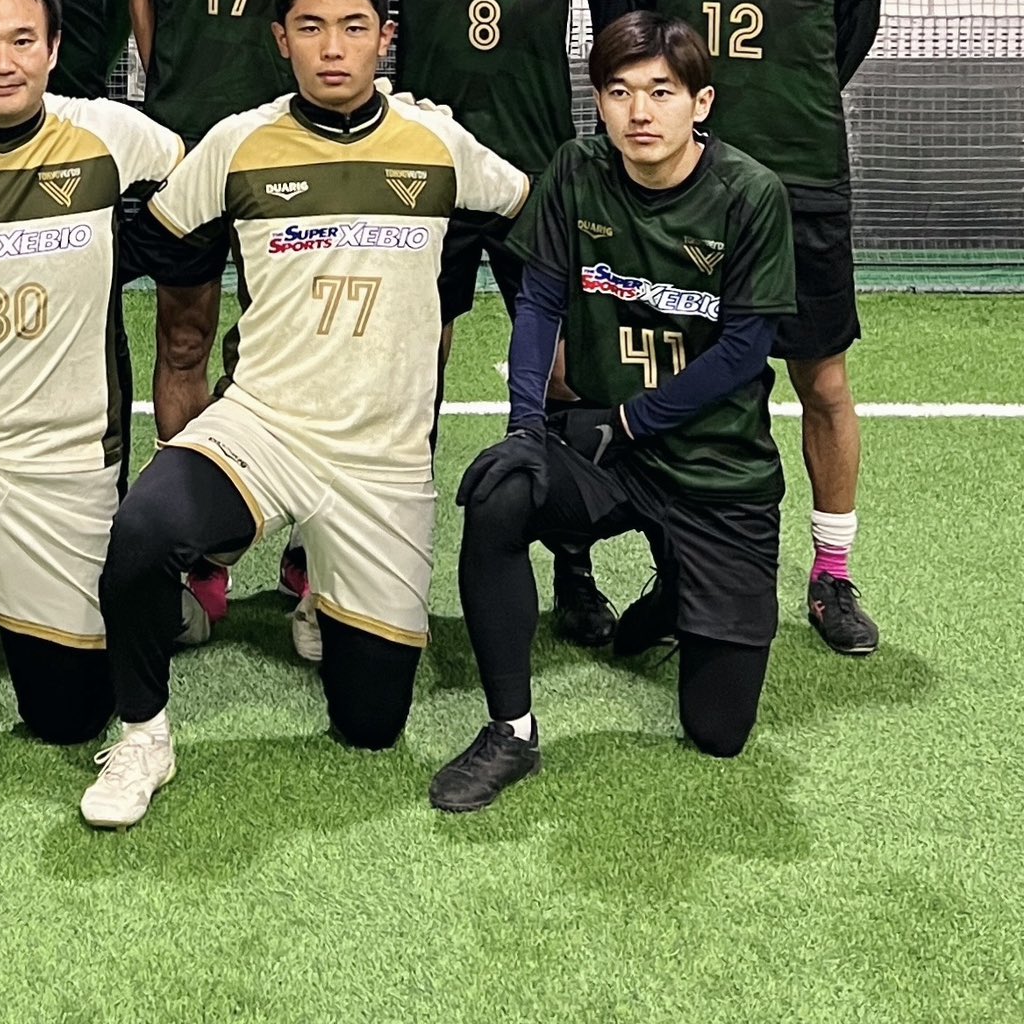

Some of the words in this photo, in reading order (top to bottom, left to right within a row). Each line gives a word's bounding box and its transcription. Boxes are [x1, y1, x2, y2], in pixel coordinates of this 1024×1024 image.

[702, 2, 763, 59] 12
[266, 180, 309, 194] DUARIG
[268, 238, 332, 253] SPORTS
[284, 225, 339, 241] SUPER
[336, 222, 429, 249] XEBIO
[595, 265, 643, 290] SUPER
[312, 276, 382, 337] 77
[619, 326, 687, 389] 41
